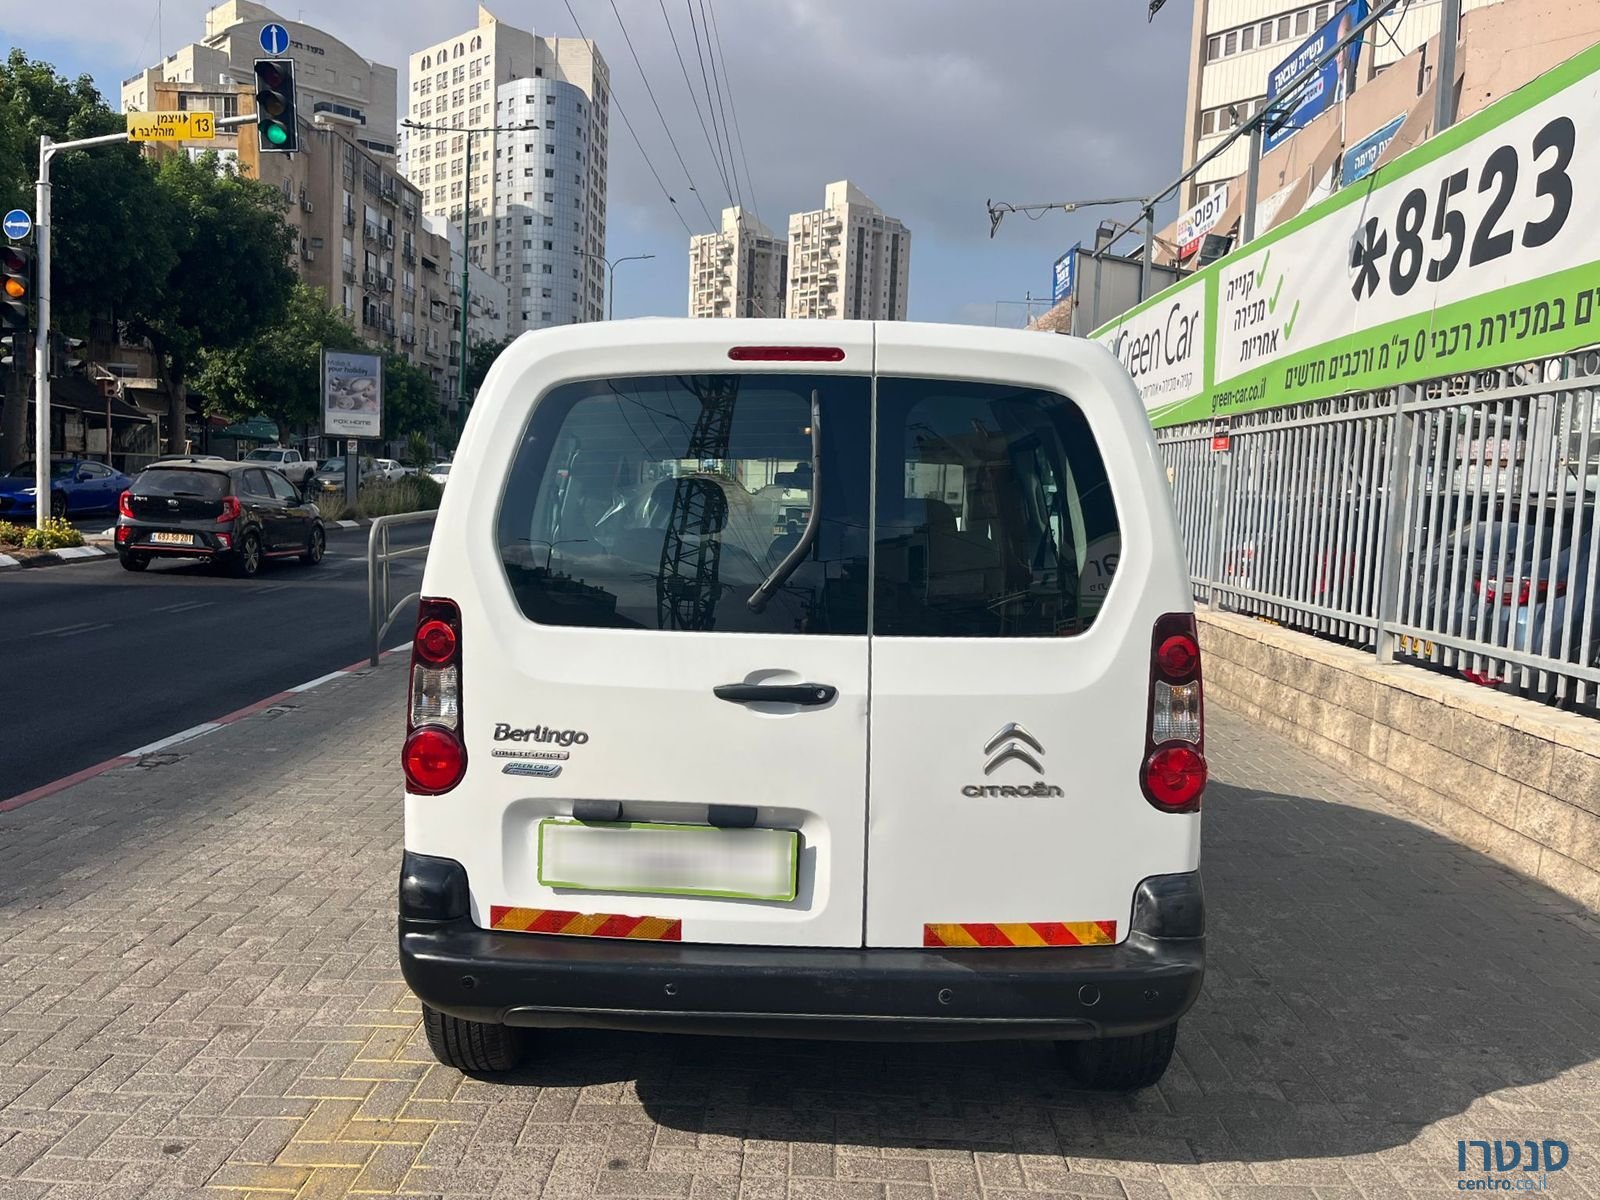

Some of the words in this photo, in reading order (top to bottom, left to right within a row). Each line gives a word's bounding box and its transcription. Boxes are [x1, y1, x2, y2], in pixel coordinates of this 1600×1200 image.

[138, 125, 175, 136] מוהליבר
[157, 114, 181, 126] ויצמן
[195, 118, 210, 132] 13
[1194, 194, 1221, 227] דפוס
[1226, 270, 1254, 301] קנייה
[1234, 299, 1266, 332] מכירה
[1476, 298, 1565, 349] במכירת
[1165, 302, 1199, 366] Car
[1240, 328, 1279, 362] אחריות
[1431, 322, 1472, 359] רכבי
[1284, 360, 1325, 390] חדשים
[1328, 347, 1374, 381] ורכבים
[1211, 376, 1267, 413] green-car.co.il
[493, 722, 589, 747] Berlingo
